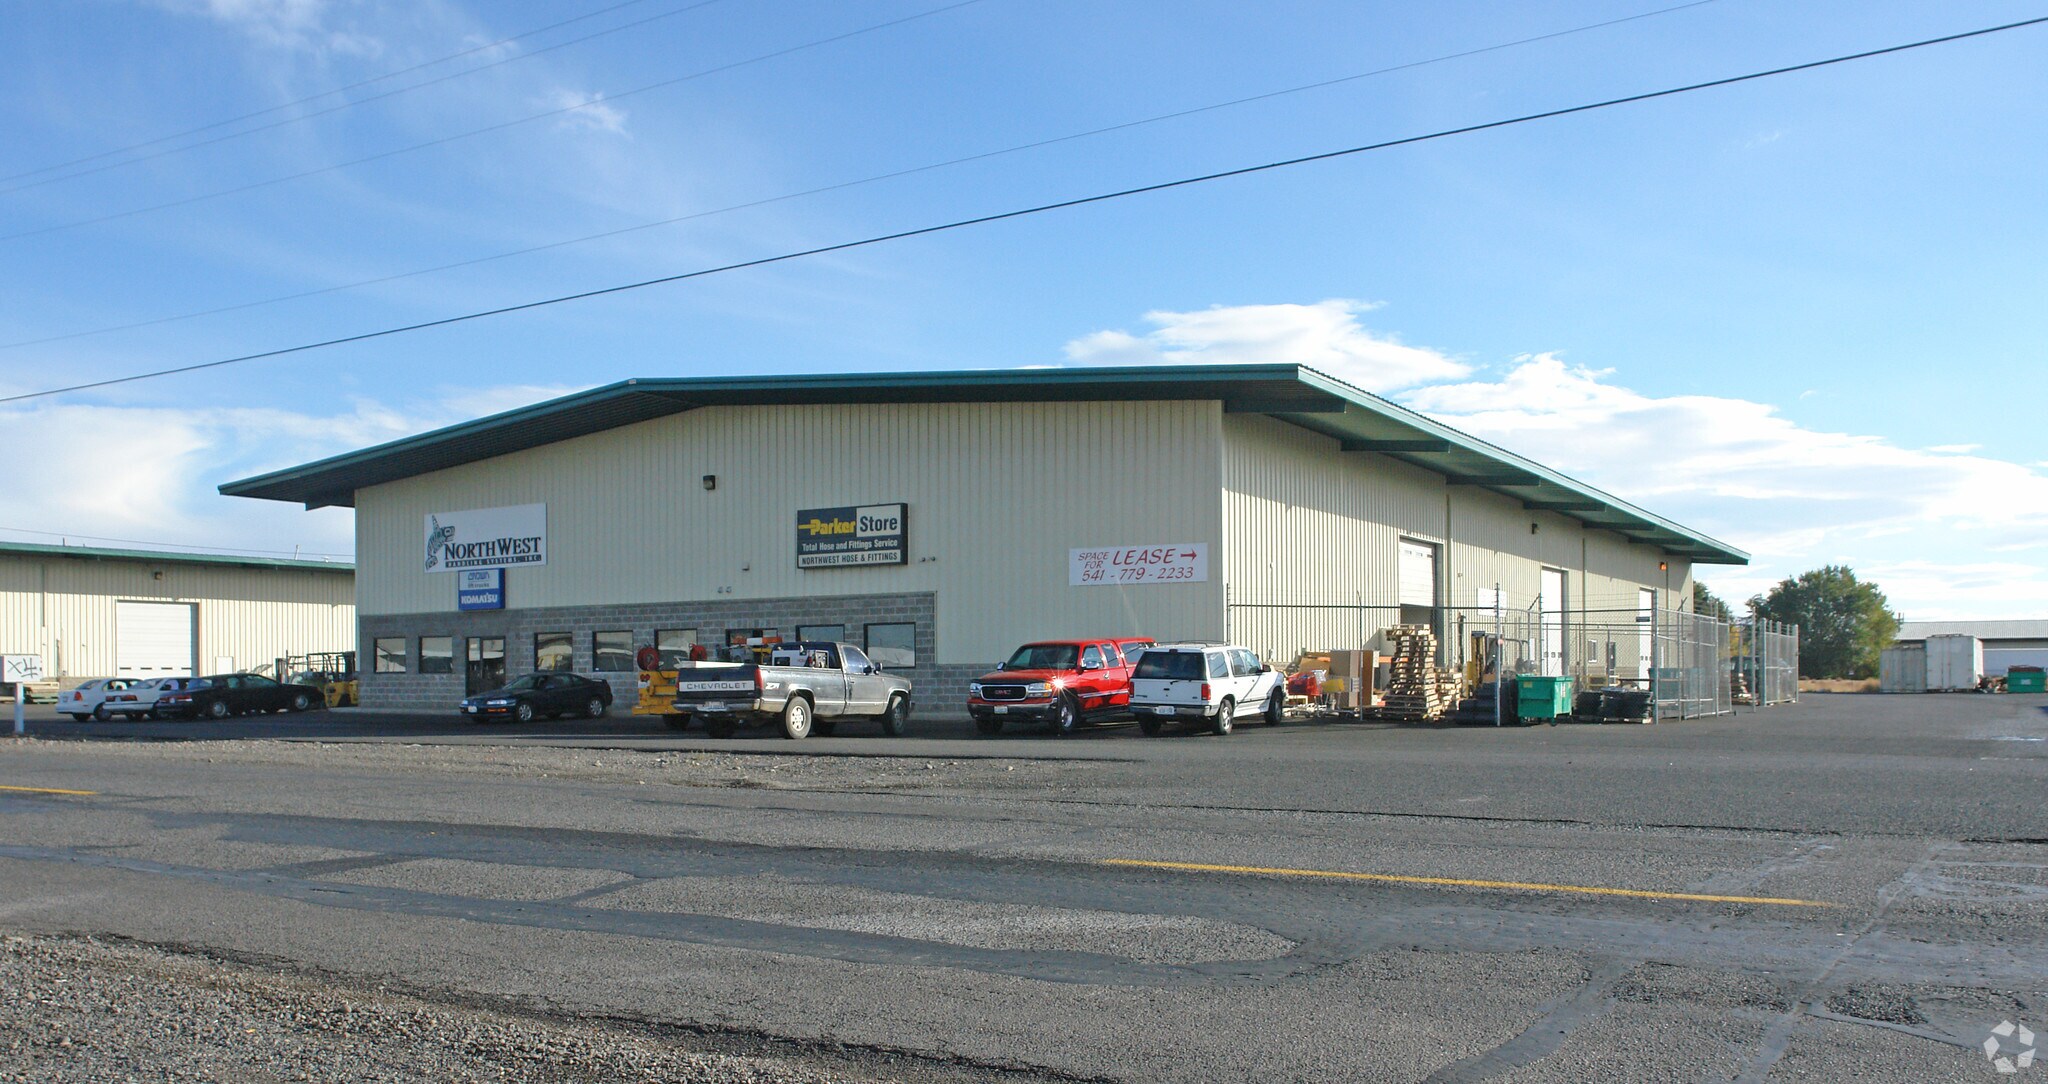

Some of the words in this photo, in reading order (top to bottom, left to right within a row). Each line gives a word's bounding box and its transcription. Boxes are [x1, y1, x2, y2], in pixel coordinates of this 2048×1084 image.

[808, 518, 856, 535] Parker
[860, 516, 897, 532] Store
[444, 536, 541, 560] NORTHWEST
[802, 542, 818, 552] Total
[819, 542, 835, 551] Hose
[836, 540, 847, 550] and
[849, 540, 872, 551] Fittings
[874, 538, 898, 548] Service
[802, 554, 839, 565] NORTHWEST
[842, 554, 858, 563] HOSE
[860, 553, 866, 562] &
[868, 552, 898, 561] FITTINGS
[1078, 551, 1109, 561] SPACE
[1112, 548, 1176, 566] LEASE
[1084, 560, 1103, 569] FOR
[461, 592, 498, 604] KOMATSU
[686, 682, 747, 690] CHEVROLET
